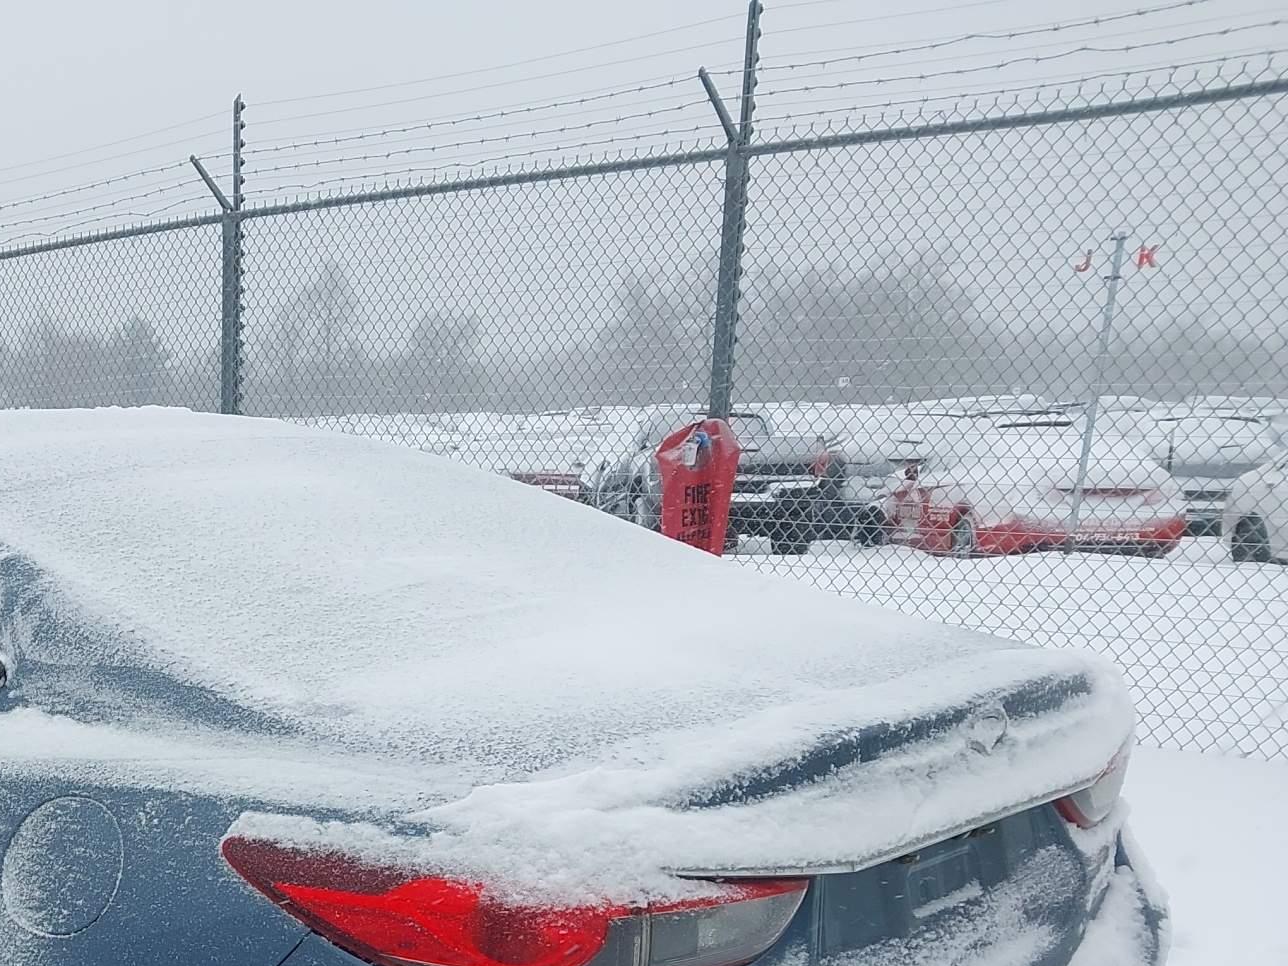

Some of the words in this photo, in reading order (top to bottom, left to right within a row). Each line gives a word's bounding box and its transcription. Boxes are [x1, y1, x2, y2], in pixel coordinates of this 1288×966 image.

[1074, 249, 1093, 272] J
[1138, 244, 1160, 270] K
[684, 482, 711, 505] FIRE
